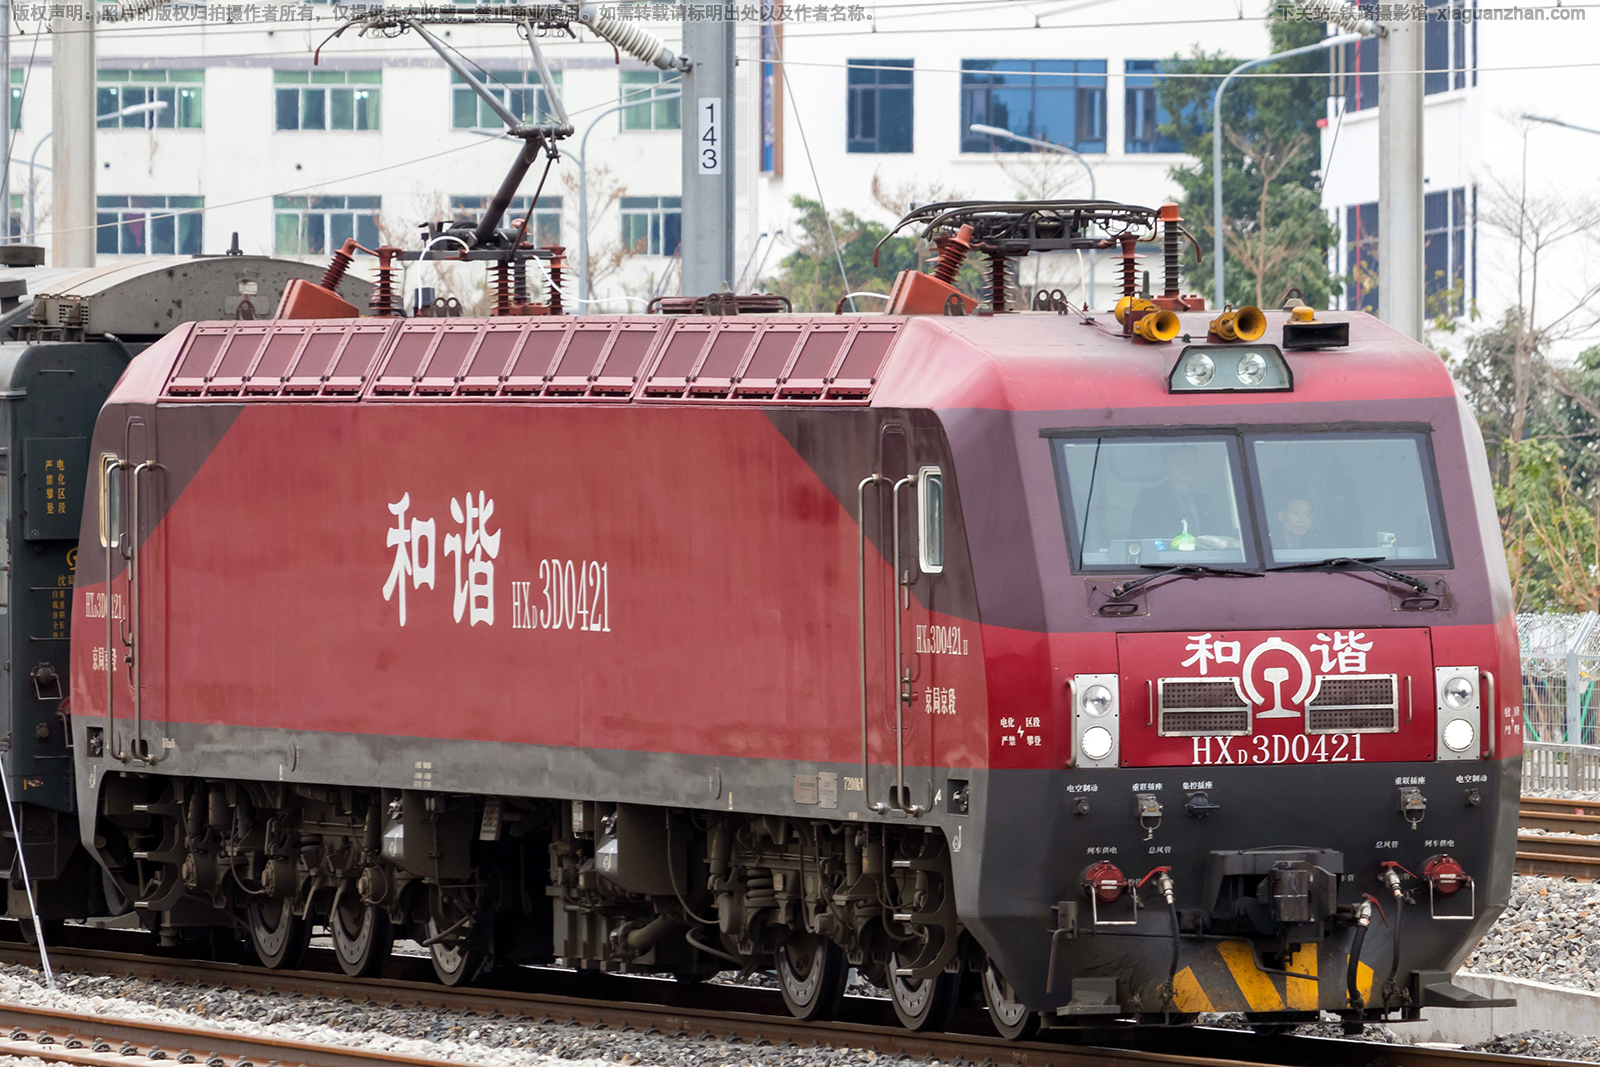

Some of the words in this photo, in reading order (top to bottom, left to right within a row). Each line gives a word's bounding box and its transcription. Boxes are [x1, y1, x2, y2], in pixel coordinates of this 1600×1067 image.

[702, 102, 717, 169] 143
[56, 459, 66, 514] 电化区段
[382, 489, 502, 628] 和谐
[85, 591, 122, 619] HXD3D21
[511, 558, 611, 632] HXD3D0421
[1181, 632, 1241, 676] 和
[1309, 630, 1374, 674] 谐
[924, 686, 956, 715] 京局京段
[1191, 732, 1366, 766] HXD3D0421
[1066, 783, 1099, 793] 电空制动
[1132, 782, 1164, 792] 重联插座
[1394, 776, 1426, 786] 重联插座
[1455, 774, 1488, 784] 电空制动
